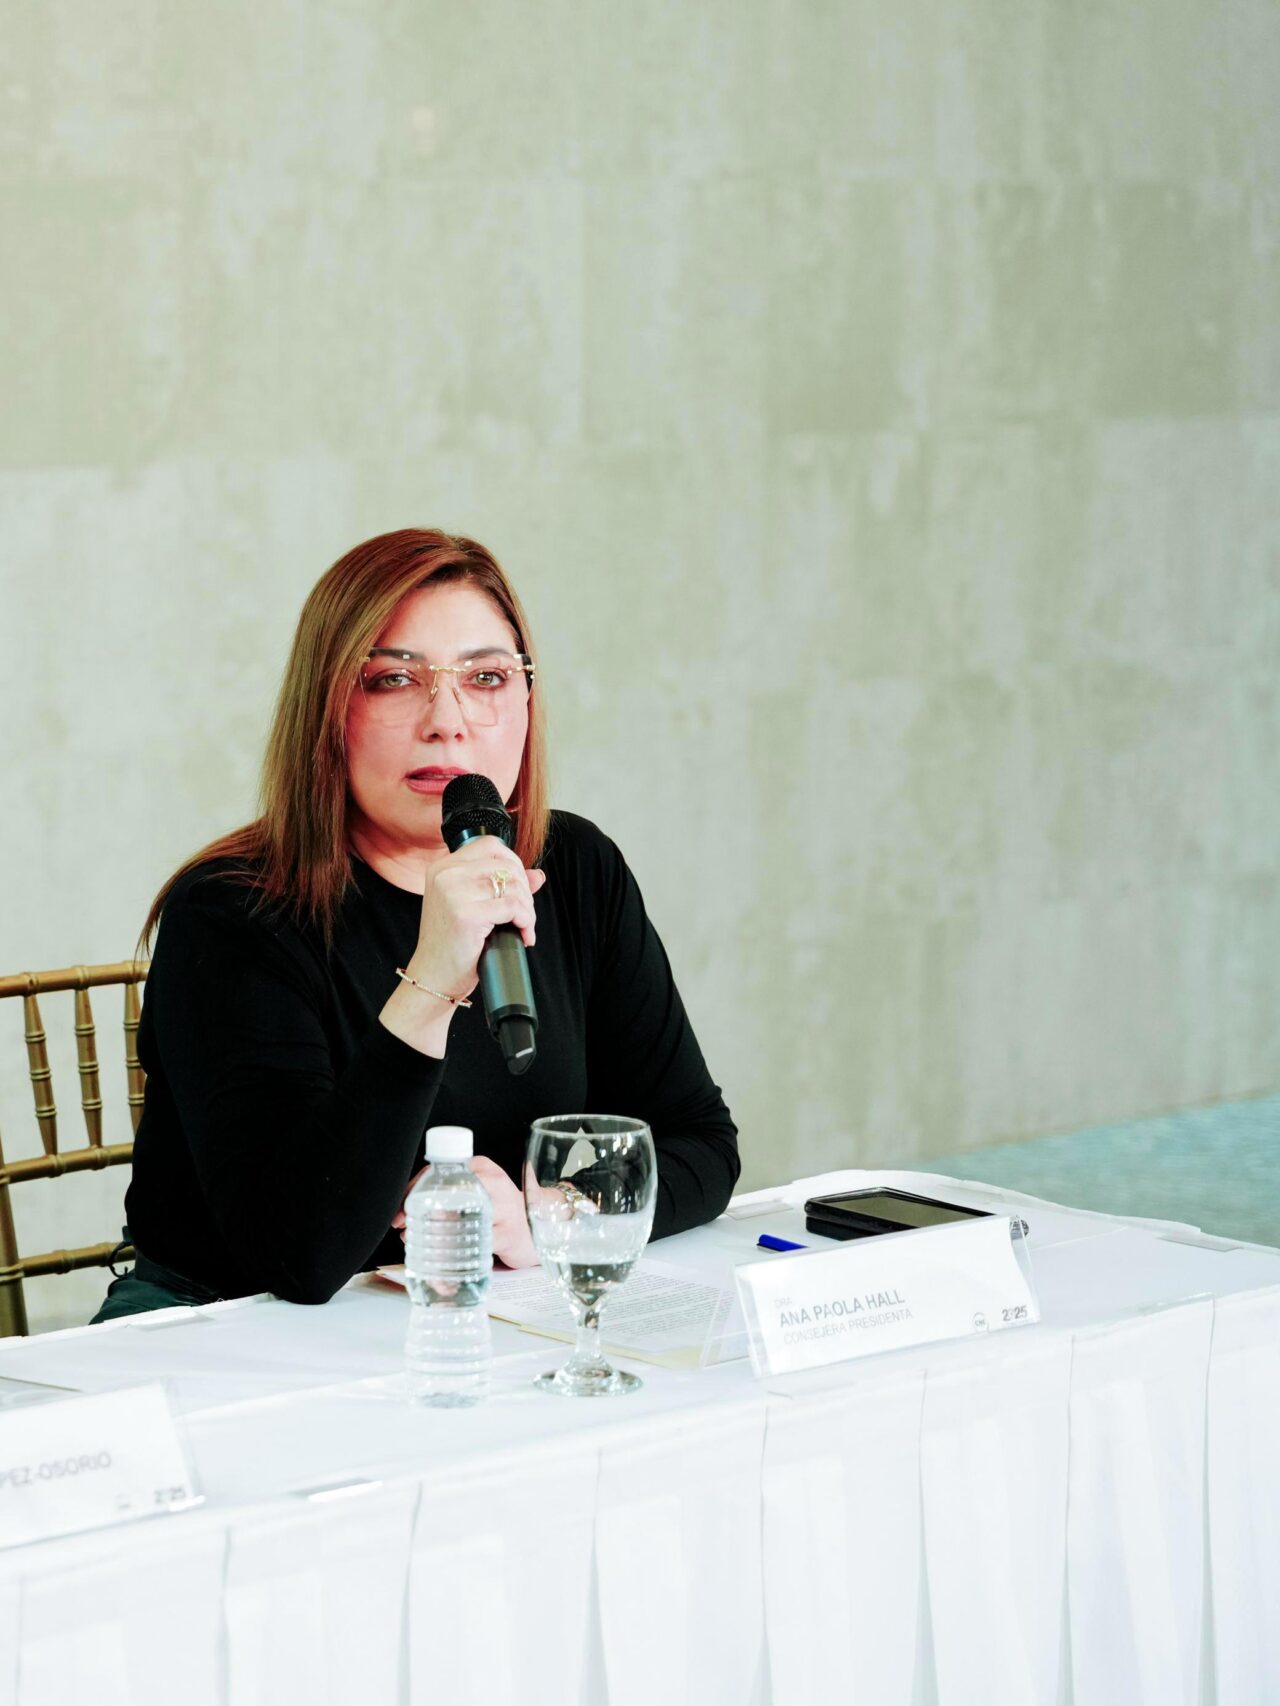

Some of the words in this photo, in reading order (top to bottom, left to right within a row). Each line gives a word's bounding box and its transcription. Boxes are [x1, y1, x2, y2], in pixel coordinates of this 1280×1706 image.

[780, 1308, 812, 1328] ANA
[813, 1297, 865, 1321] PAOLA
[865, 1289, 907, 1309] HALL
[783, 1322, 847, 1345] CONSEJERA
[848, 1308, 914, 1330] PRESIDENTA
